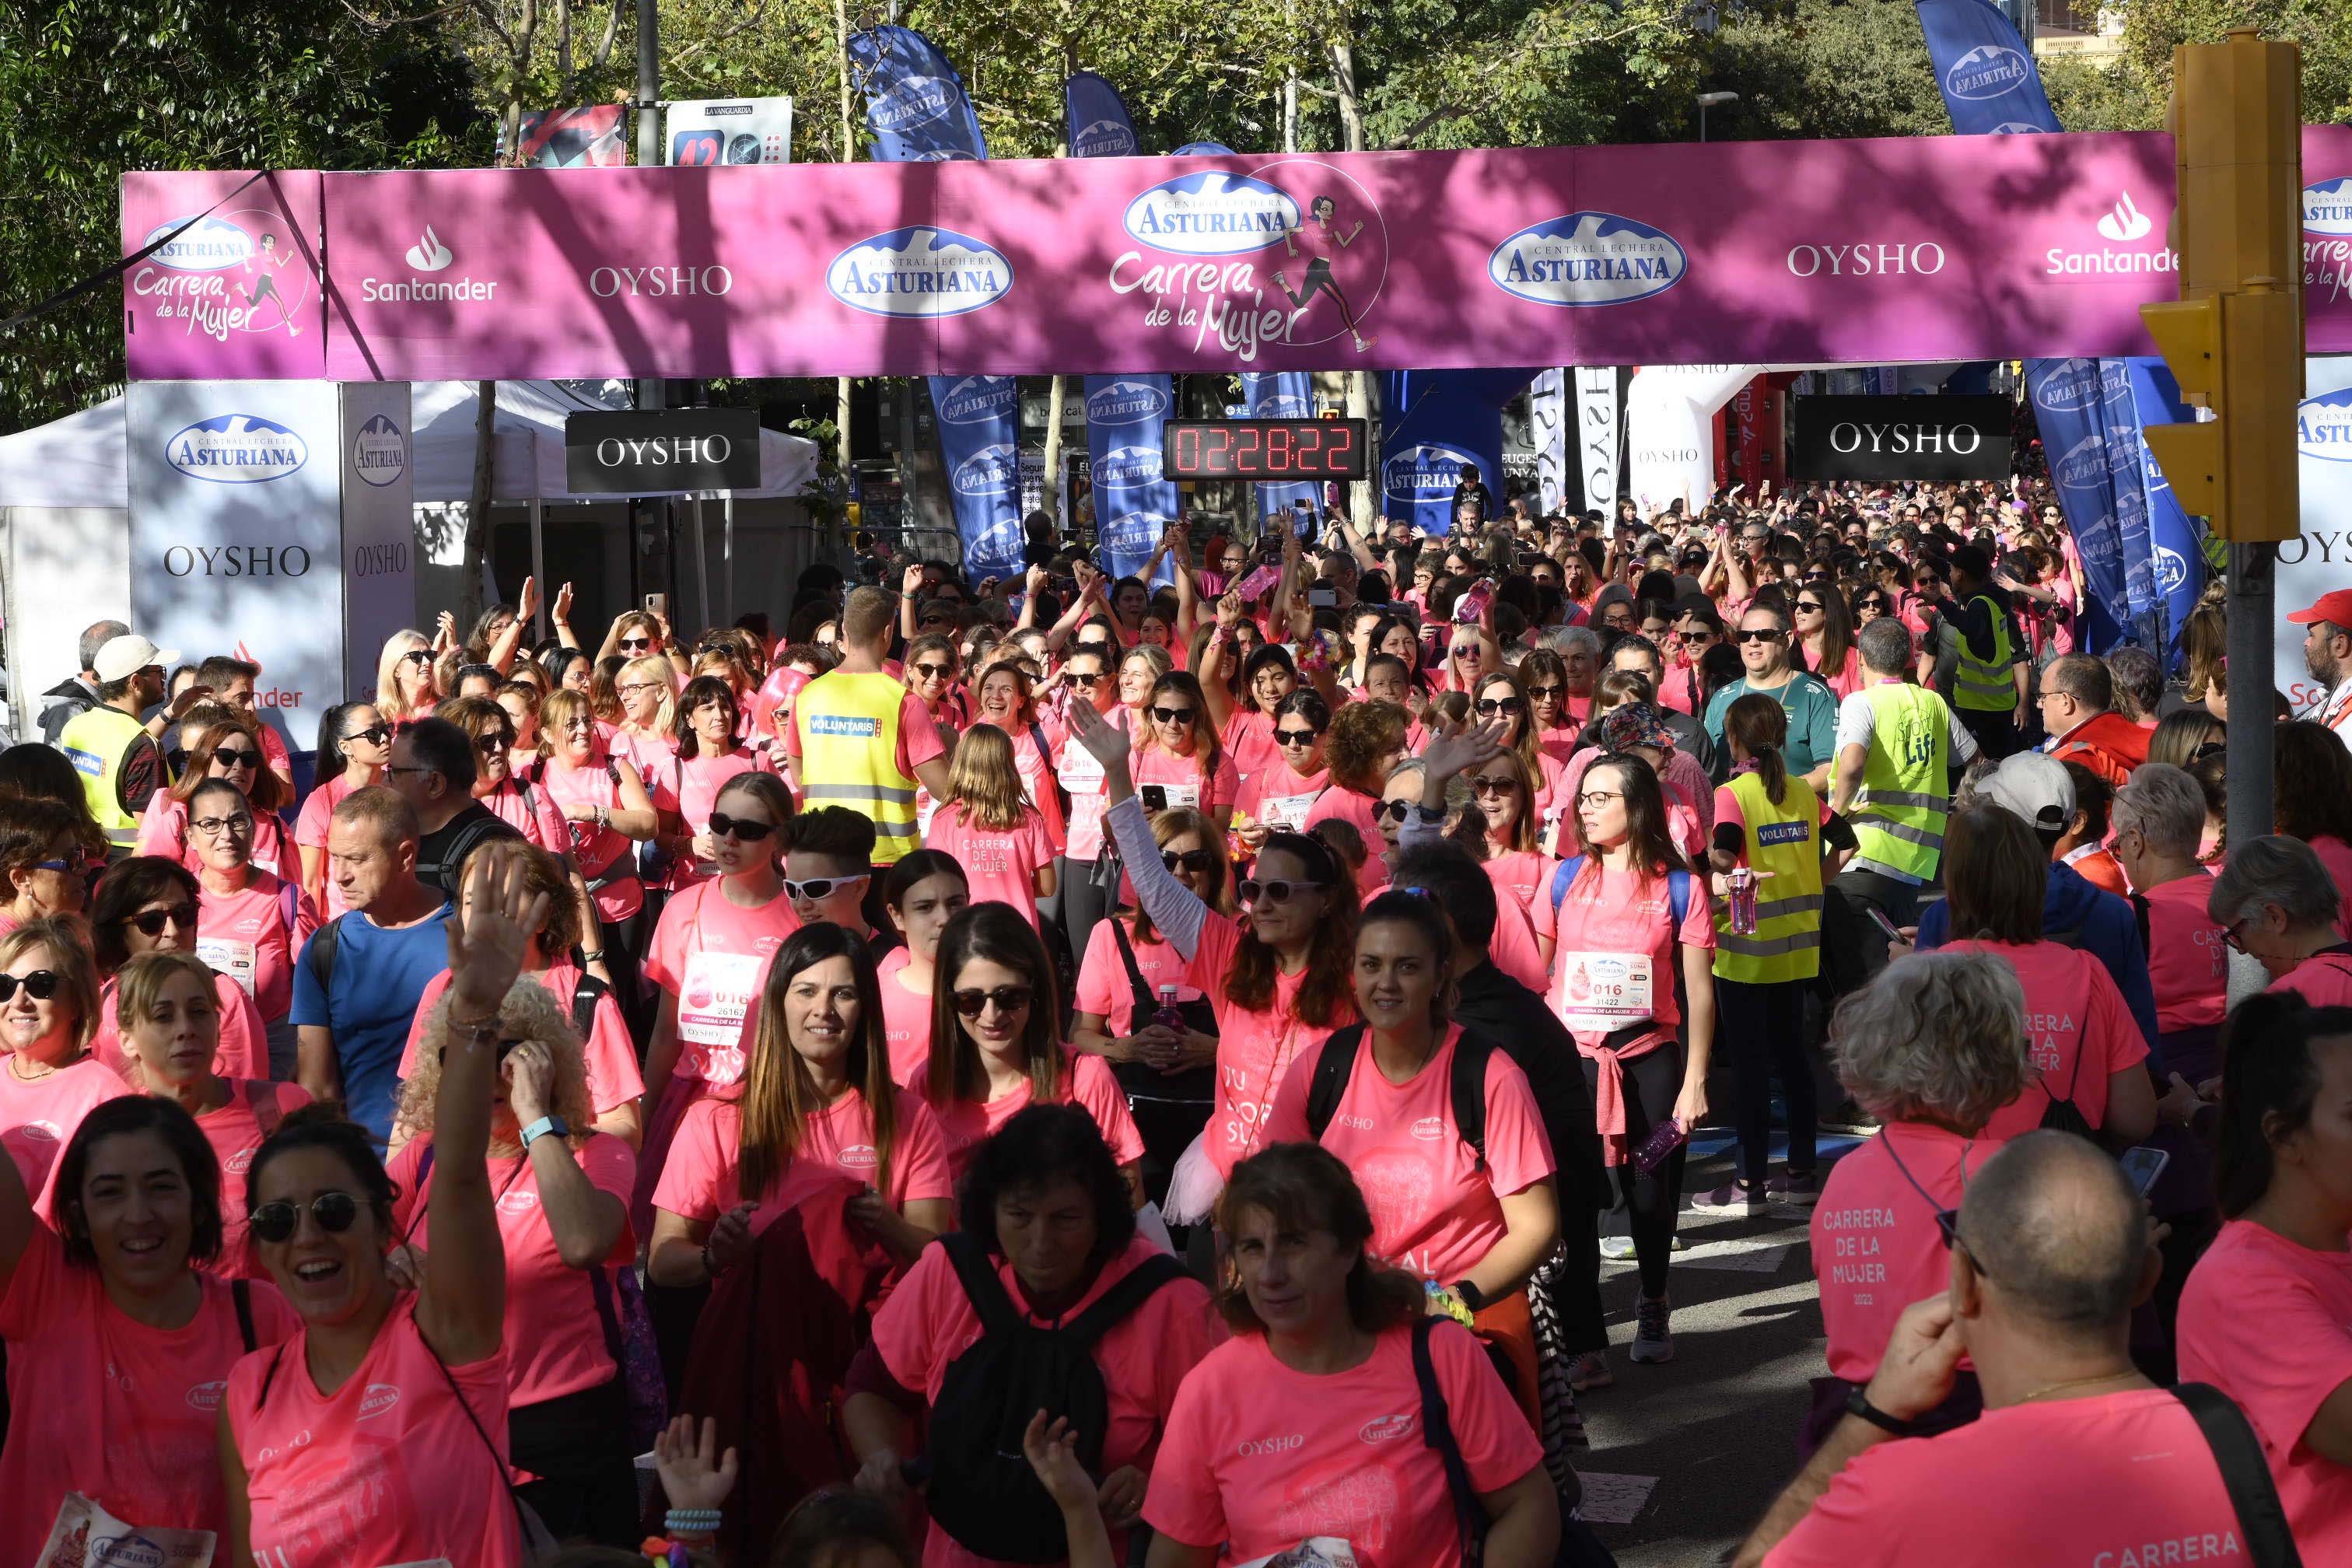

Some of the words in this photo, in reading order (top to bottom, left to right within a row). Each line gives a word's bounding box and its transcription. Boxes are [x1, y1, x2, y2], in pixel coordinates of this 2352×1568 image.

[1138, 202, 1287, 234] ASTURIANA
[934, 257, 993, 266] LECHERA
[1534, 243, 1596, 255] CENTRAL
[1601, 243, 1665, 254] LECHERA
[1787, 242, 1945, 277] OYSHO
[841, 261, 999, 294] ASTURIANA
[1108, 250, 1256, 295] Carrera
[1503, 247, 1672, 283] ASTURIANA
[133, 267, 225, 296] Carrera
[361, 277, 498, 303] Santander
[589, 265, 733, 297] OYSHO
[156, 296, 173, 317] de
[177, 296, 189, 317] la
[187, 293, 260, 342] Mujer
[1144, 297, 1171, 327] de
[1178, 296, 1197, 327] la
[1194, 289, 1309, 362] Mujer
[596, 433, 732, 467] OYSHO
[1177, 428, 1350, 471] 02:28:22
[1829, 422, 1980, 454] OYSHO
[176, 439, 298, 467] ASTURIANA
[356, 441, 403, 470] ASTURIANA
[1638, 448, 1698, 464] OYSHO
[1386, 470, 1464, 490] ASTURIAN
[163, 545, 311, 577] OYSHO
[354, 542, 408, 578] OYSHO
[962, 840, 1014, 850] CARRERA
[973, 850, 987, 861] DE
[991, 850, 1005, 861] LA
[971, 863, 1008, 872] MUJER
[1594, 984, 1623, 996] 016
[717, 1007, 744, 1017] 26162
[688, 1027, 718, 1038] OYSHO
[1823, 1208, 1896, 1230] CARRERA
[1836, 1237, 1856, 1257] DE
[1862, 1236, 1881, 1255] LA
[1832, 1263, 1886, 1284] MUJER
[1237, 1433, 1304, 1457] OYSHO
[2093, 1531, 2241, 1568] CARRERA
